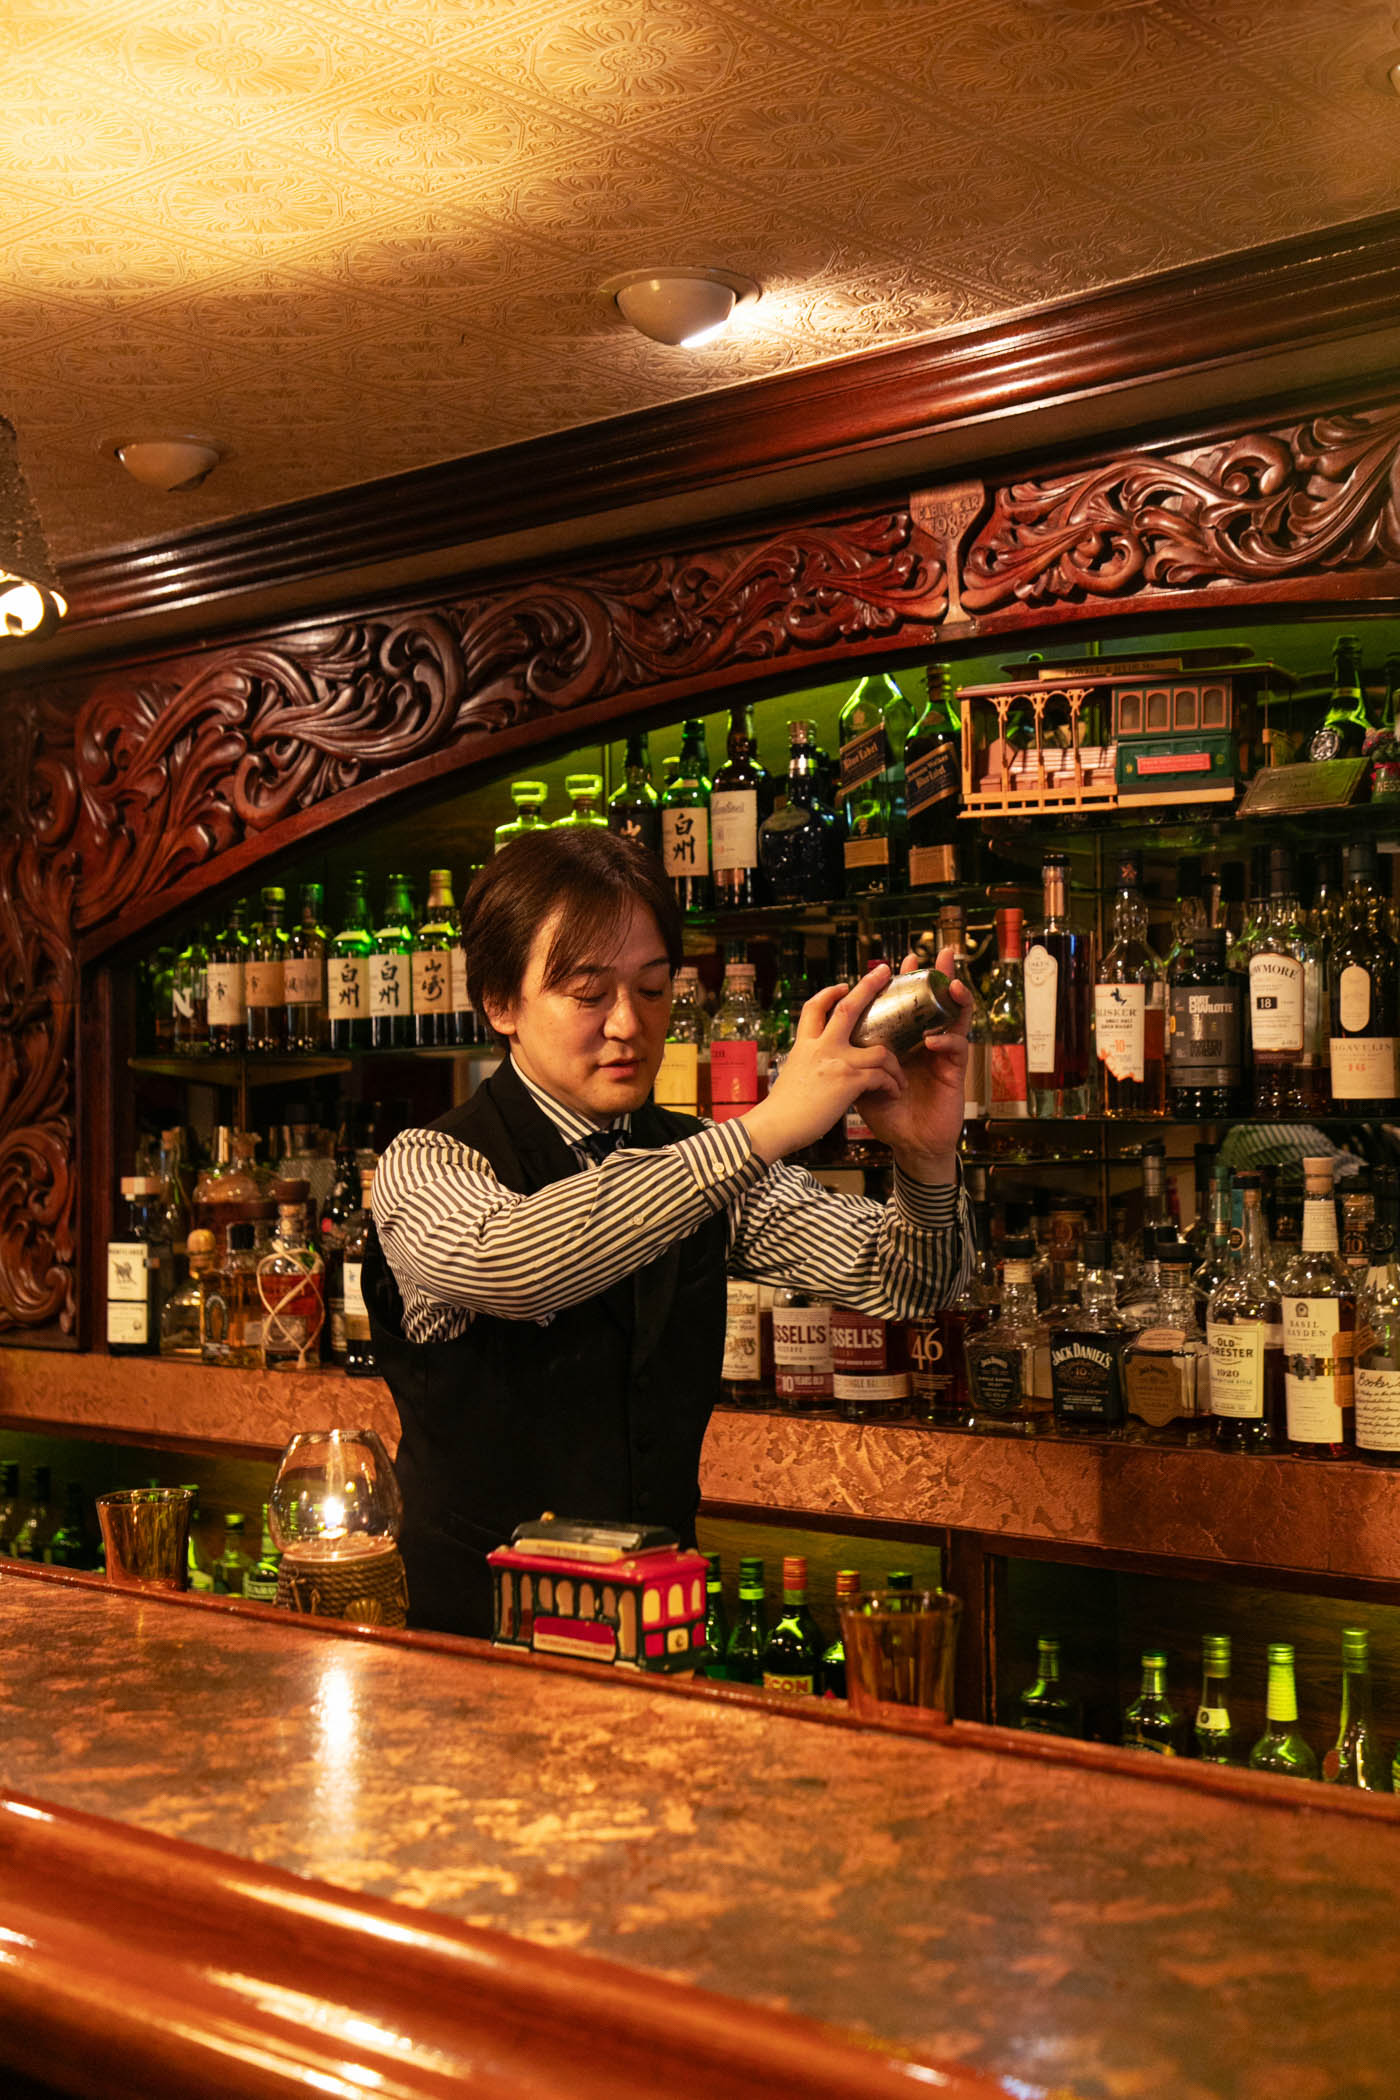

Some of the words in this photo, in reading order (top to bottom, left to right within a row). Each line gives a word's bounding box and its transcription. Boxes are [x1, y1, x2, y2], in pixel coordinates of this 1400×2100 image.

[673, 813, 696, 864] 白州
[339, 963, 359, 1008] 白州
[379, 961, 399, 1008] 白州
[1260, 998, 1272, 1009] 18
[911, 1327, 944, 1370] 46
[1052, 1346, 1074, 1366] JACK
[1073, 1342, 1113, 1369] DANIEL'S
[1217, 1337, 1235, 1348] OLD
[781, 1375, 795, 1393] 10
